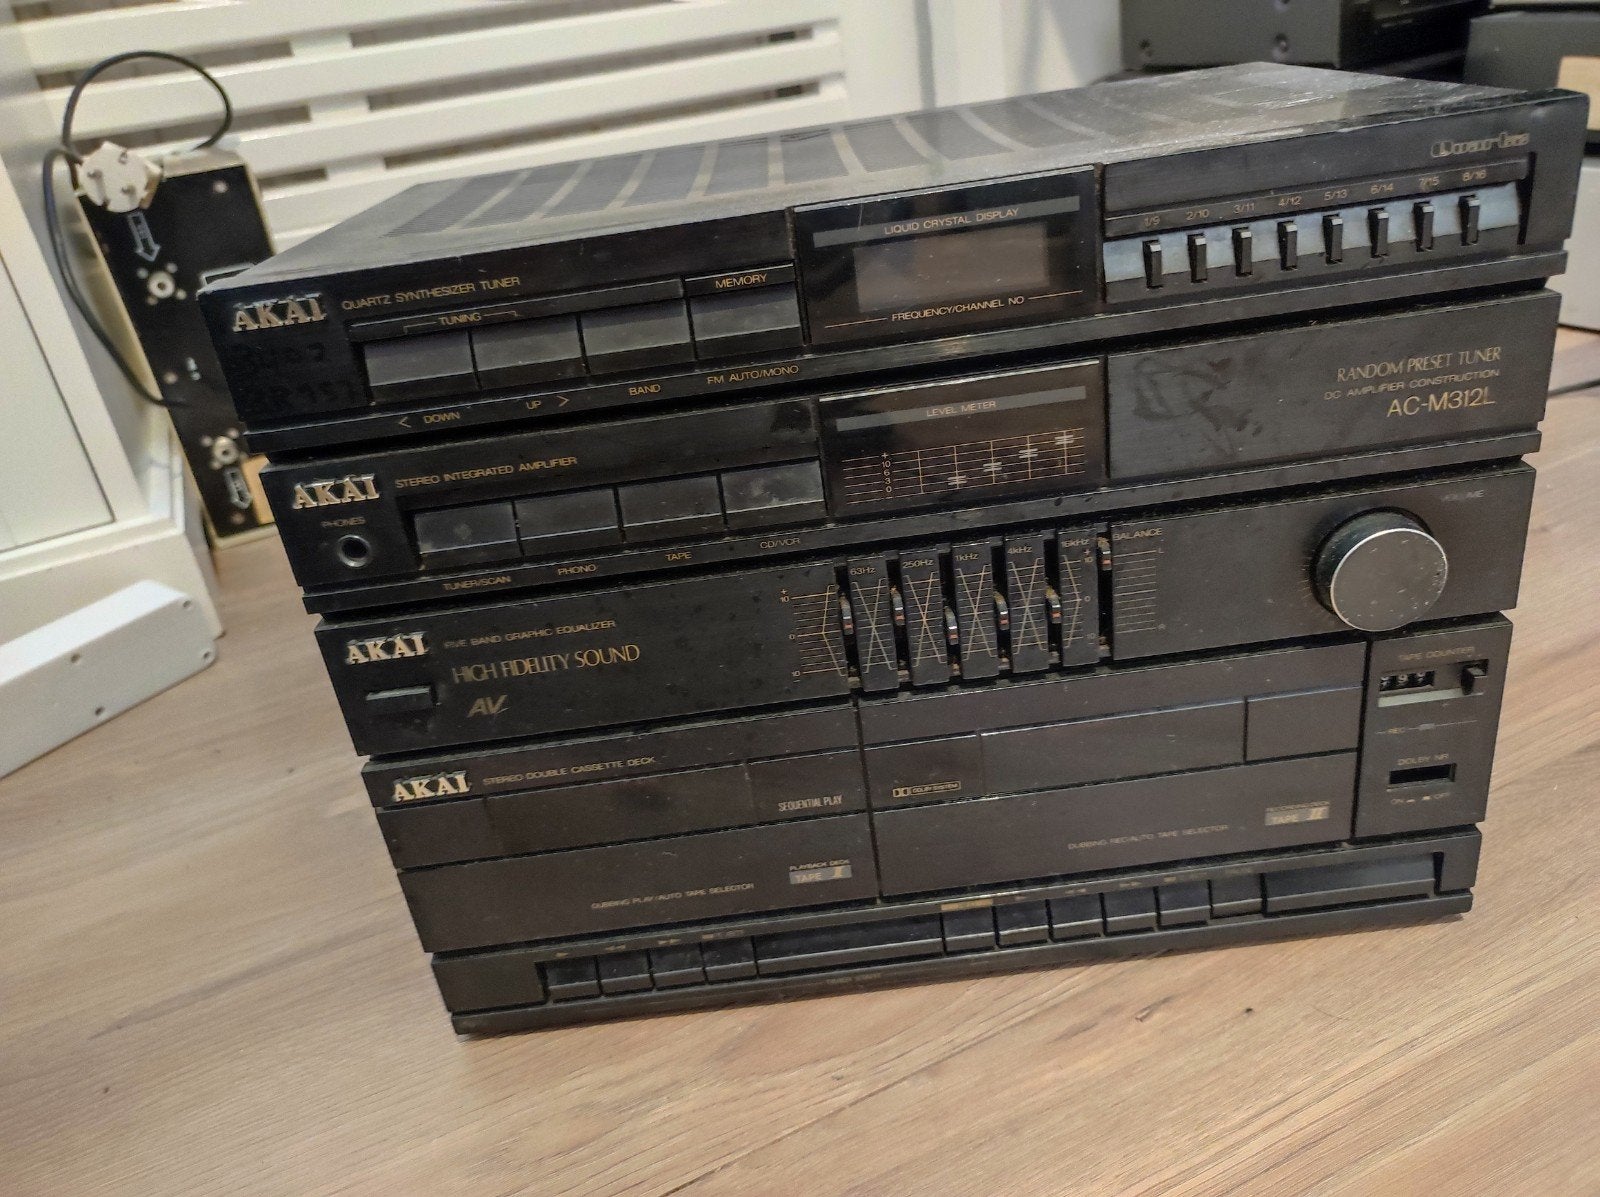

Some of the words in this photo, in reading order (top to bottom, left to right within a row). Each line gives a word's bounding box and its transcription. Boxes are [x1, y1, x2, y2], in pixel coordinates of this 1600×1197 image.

[1418, 175, 1440, 190] 7/15
[1461, 169, 1487, 182] 8/16
[1323, 188, 1349, 201] 5/13
[1370, 182, 1395, 194] 6/14
[1233, 202, 1256, 214] 3/11
[1278, 195, 1303, 207] 4/12
[884, 221, 919, 237] LIQUID
[922, 215, 973, 231] CRYSTAL
[976, 207, 1020, 222] DISPLAY
[1144, 215, 1161, 228] 1/9
[1186, 208, 1210, 221] 2/10
[714, 272, 769, 290] MEMORY
[341, 294, 392, 310] QUARTZ
[394, 283, 476, 305] SYNTHESIZER
[479, 276, 522, 293] TUNER
[231, 292, 328, 333] AKAI
[891, 300, 1005, 322] FREQUENCY/CHANNEL
[1008, 295, 1025, 306] NO
[438, 312, 483, 326] TUNING
[1336, 359, 1404, 384] RANDOM
[1407, 352, 1453, 375] PRESET
[1458, 346, 1502, 366] TUNER
[706, 375, 725, 387] FM
[728, 365, 800, 383] AUTO/MONO
[1346, 380, 1405, 399] AMPLIFIER
[1408, 368, 1500, 389] CONSTRUCTION
[627, 383, 662, 397] BAND
[525, 399, 543, 411] UP
[926, 404, 959, 418] LEVEL
[962, 400, 997, 413] METER
[1385, 386, 1497, 419] AC-M312L
[422, 410, 461, 425] DOWN
[394, 475, 441, 489] STEREO
[443, 465, 515, 483] INTEGRATED
[518, 456, 578, 475] AMPLIFIER
[291, 473, 381, 510] AKAI
[321, 516, 368, 529] PHONES
[759, 536, 802, 550] CD/VCR
[1112, 526, 1163, 543] BALANCE
[665, 551, 693, 562] TAPE
[902, 558, 935, 570] 250Hz
[556, 563, 598, 577] PHONO
[849, 565, 877, 577] 63Hz
[442, 575, 513, 592] TUNER/SCAN
[470, 634, 503, 647] BAND
[505, 628, 554, 642] GRAPHIC
[556, 620, 617, 636] EQUALIZER
[344, 629, 431, 666] AKAI
[451, 662, 498, 685] HIGH
[500, 651, 570, 679] FIDELITY
[575, 643, 641, 669] SOUND
[466, 694, 509, 719] AV
[482, 773, 525, 786] STEREO
[526, 766, 569, 780] DOUBLE
[571, 759, 625, 775] CASSETTE
[627, 755, 658, 768] DECK
[391, 770, 472, 803] AKAI
[777, 796, 824, 812] SEQUENTIAL
[823, 793, 844, 807] PLAY
[795, 872, 822, 884] TAPE
[686, 888, 707, 899] TAPE
[709, 881, 755, 895] SELECTOR
